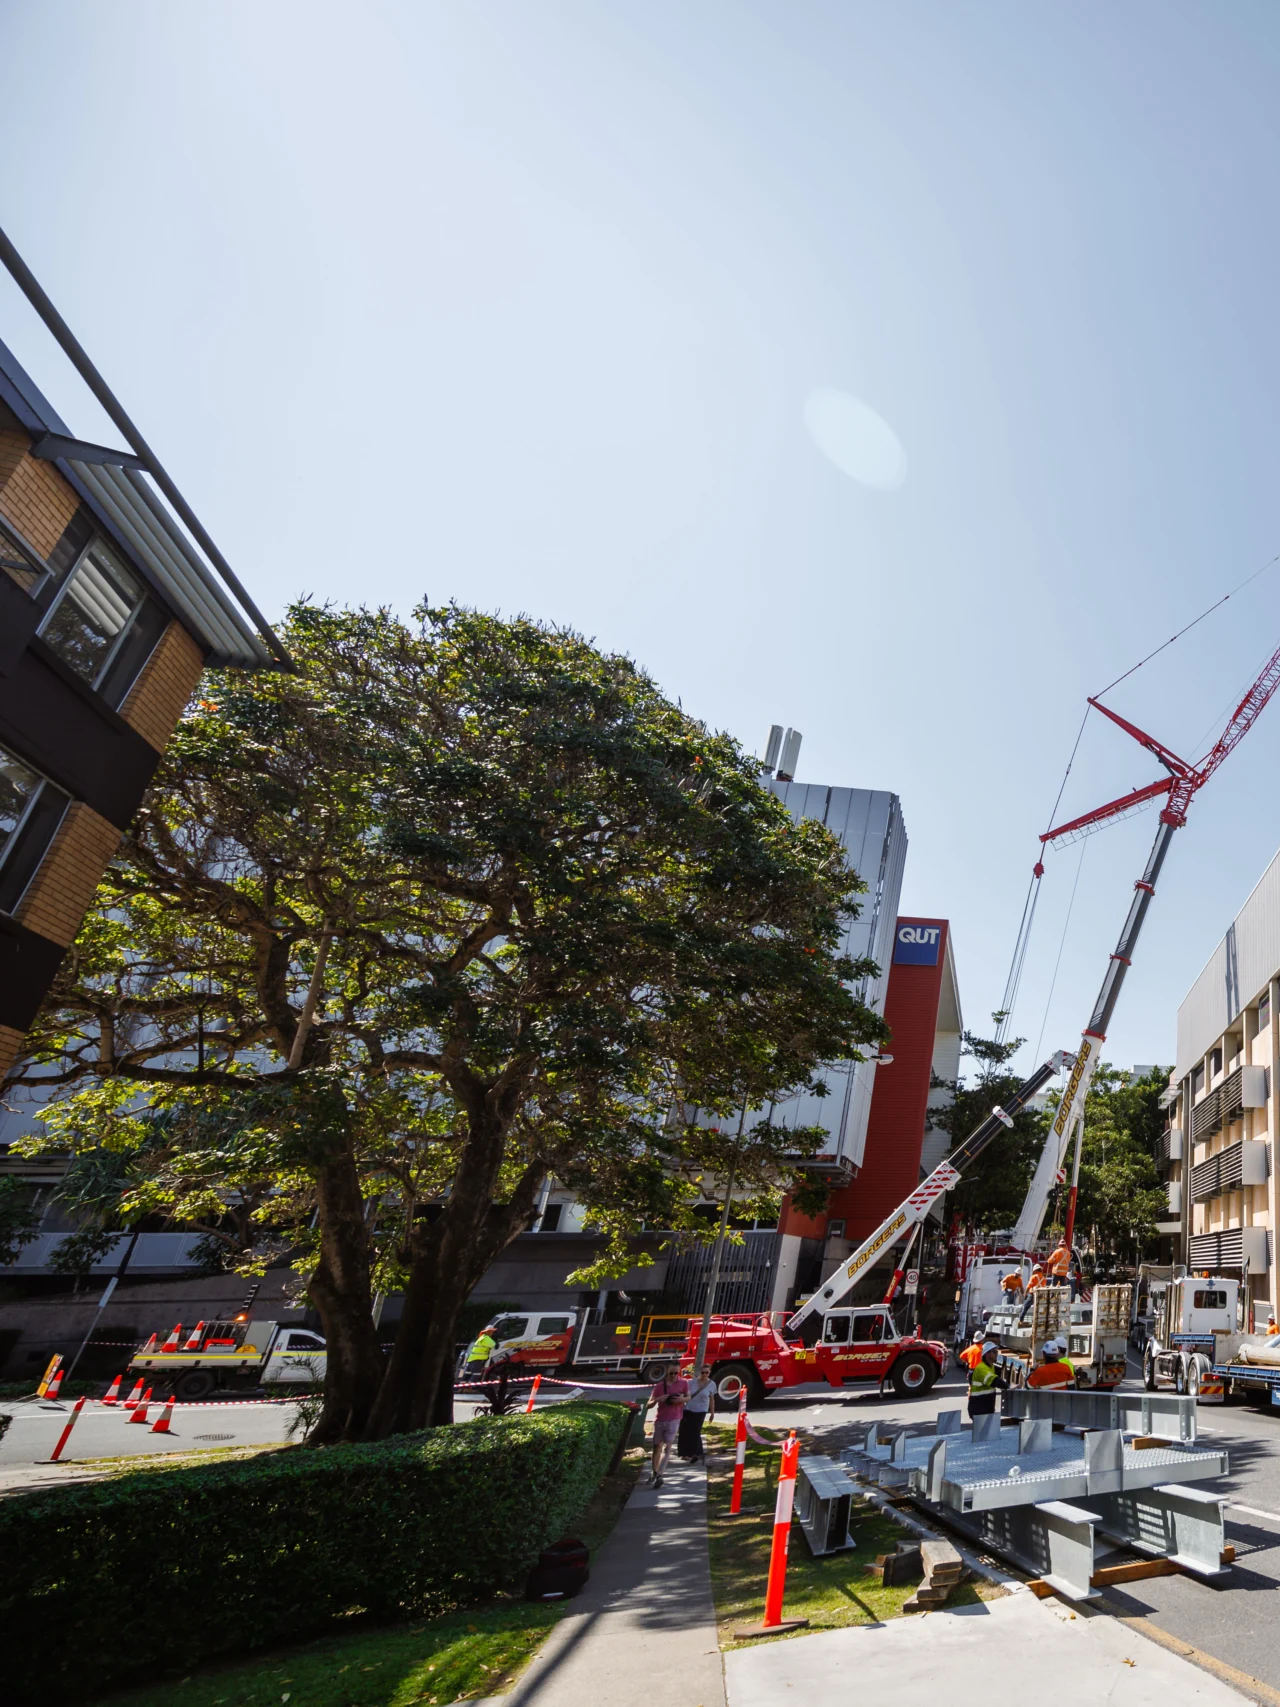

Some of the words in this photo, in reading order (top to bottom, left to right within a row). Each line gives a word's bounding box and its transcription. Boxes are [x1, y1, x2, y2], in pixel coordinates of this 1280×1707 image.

[899, 927, 940, 944] QUT
[1054, 1039, 1091, 1137] BORGERS
[847, 1211, 907, 1279] BORGERS
[504, 1340, 563, 1349] BORGER
[832, 1352, 891, 1362] BORGER
